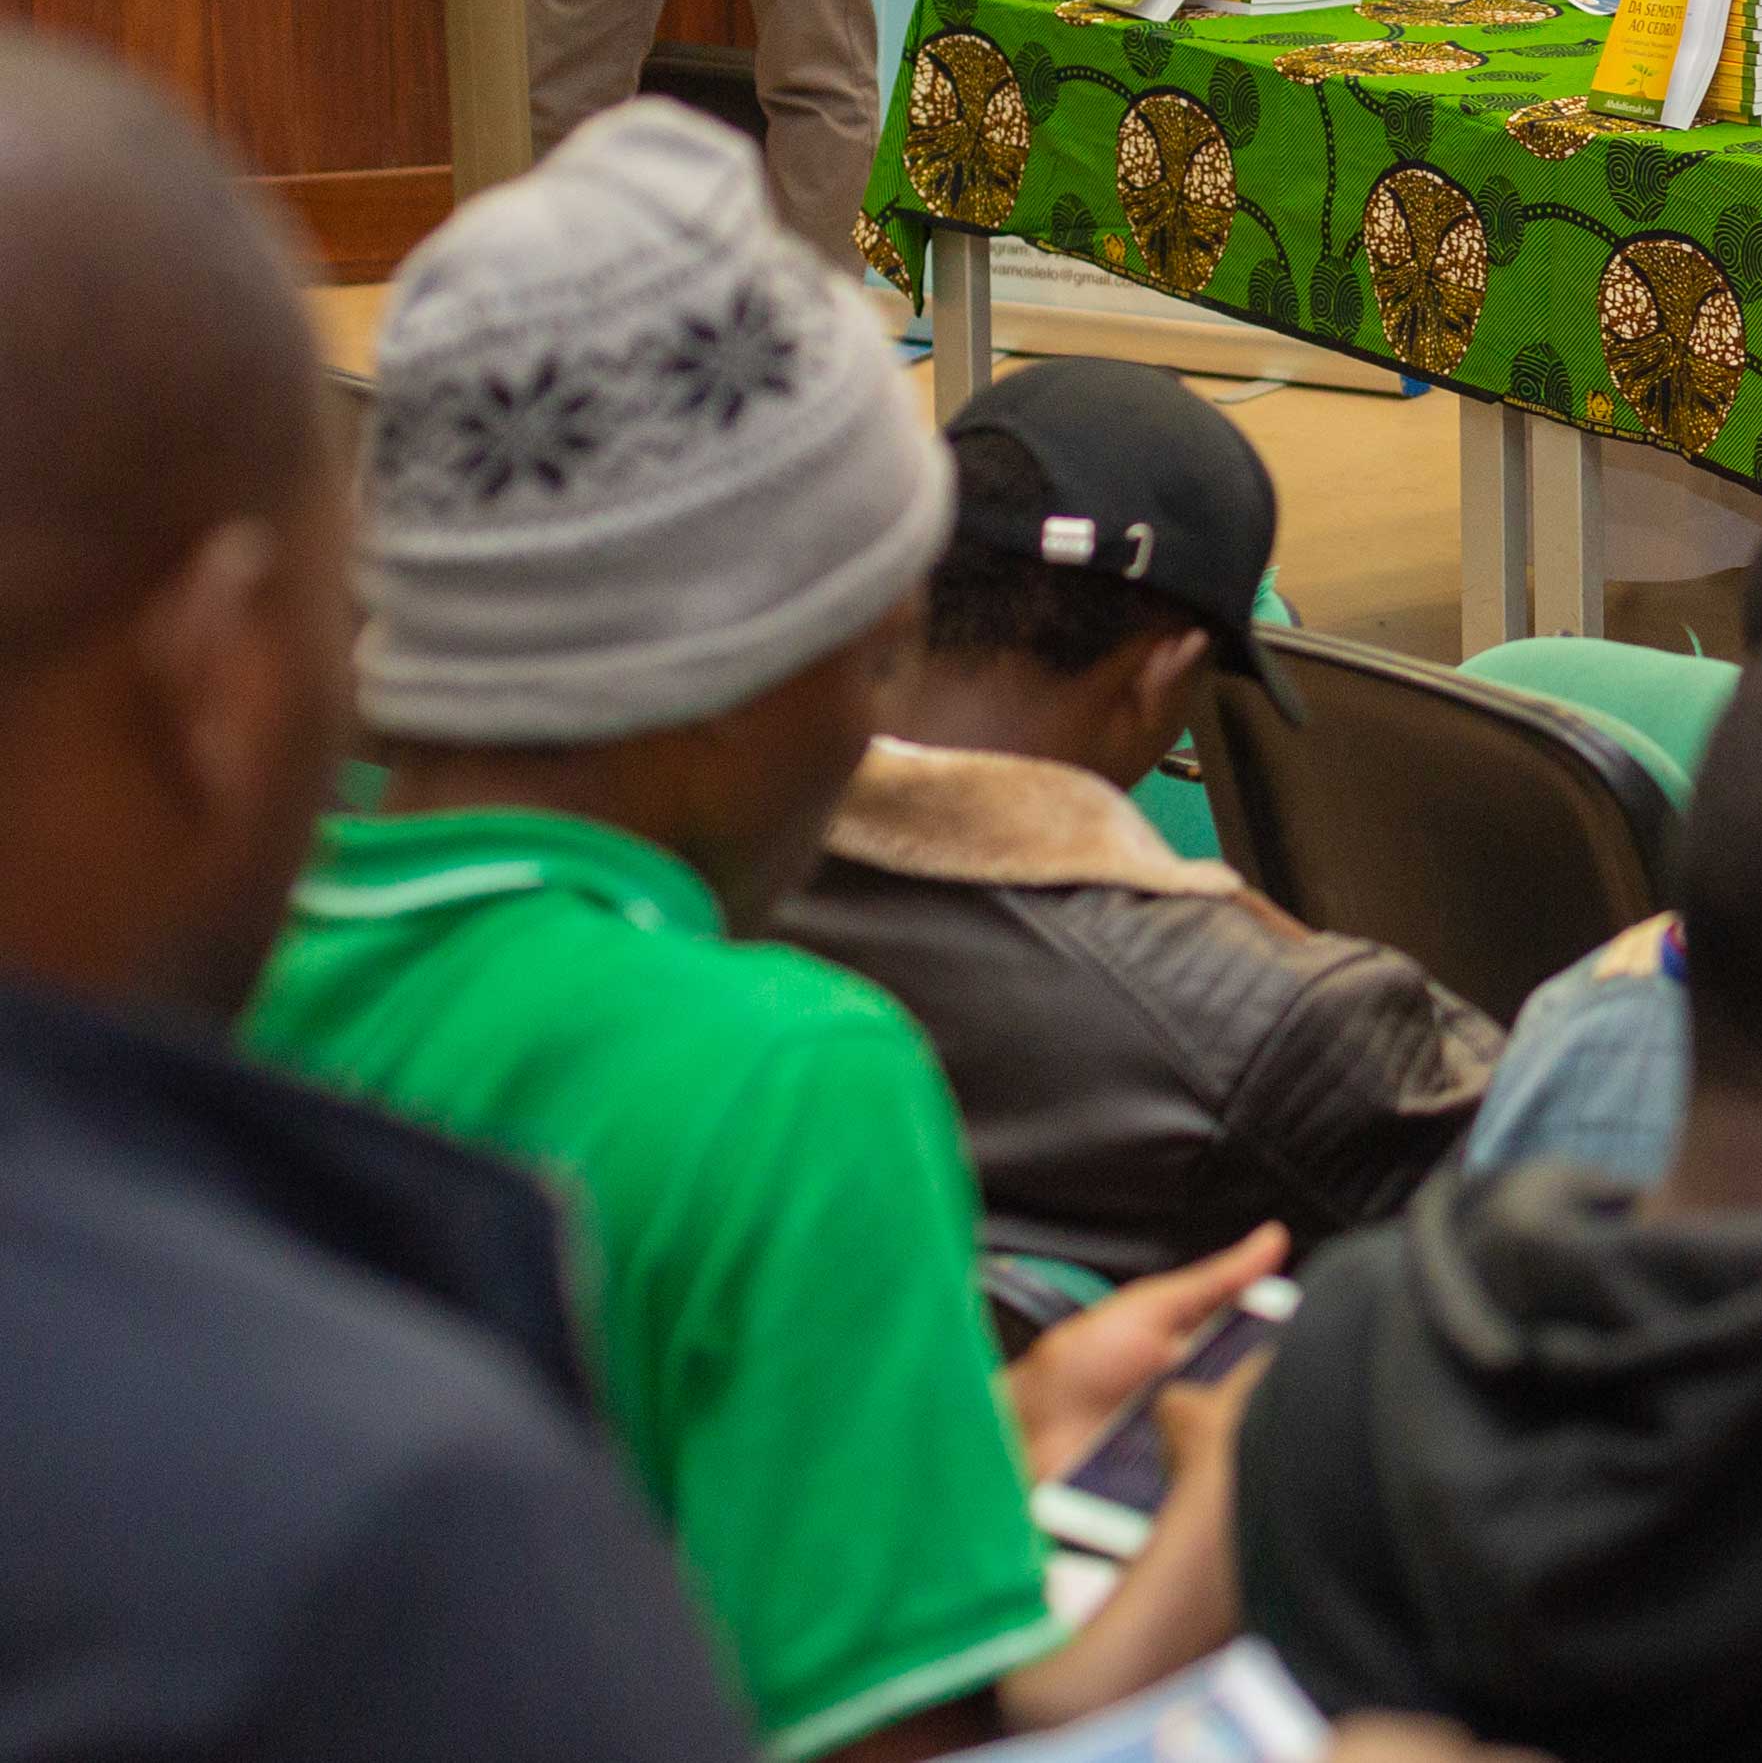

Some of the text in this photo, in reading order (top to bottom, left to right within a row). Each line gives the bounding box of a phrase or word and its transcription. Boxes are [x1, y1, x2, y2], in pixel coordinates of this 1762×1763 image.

[1628, 0, 1685, 20] DA SEMENTE
[1629, 19, 1677, 37] AO CEDRO
